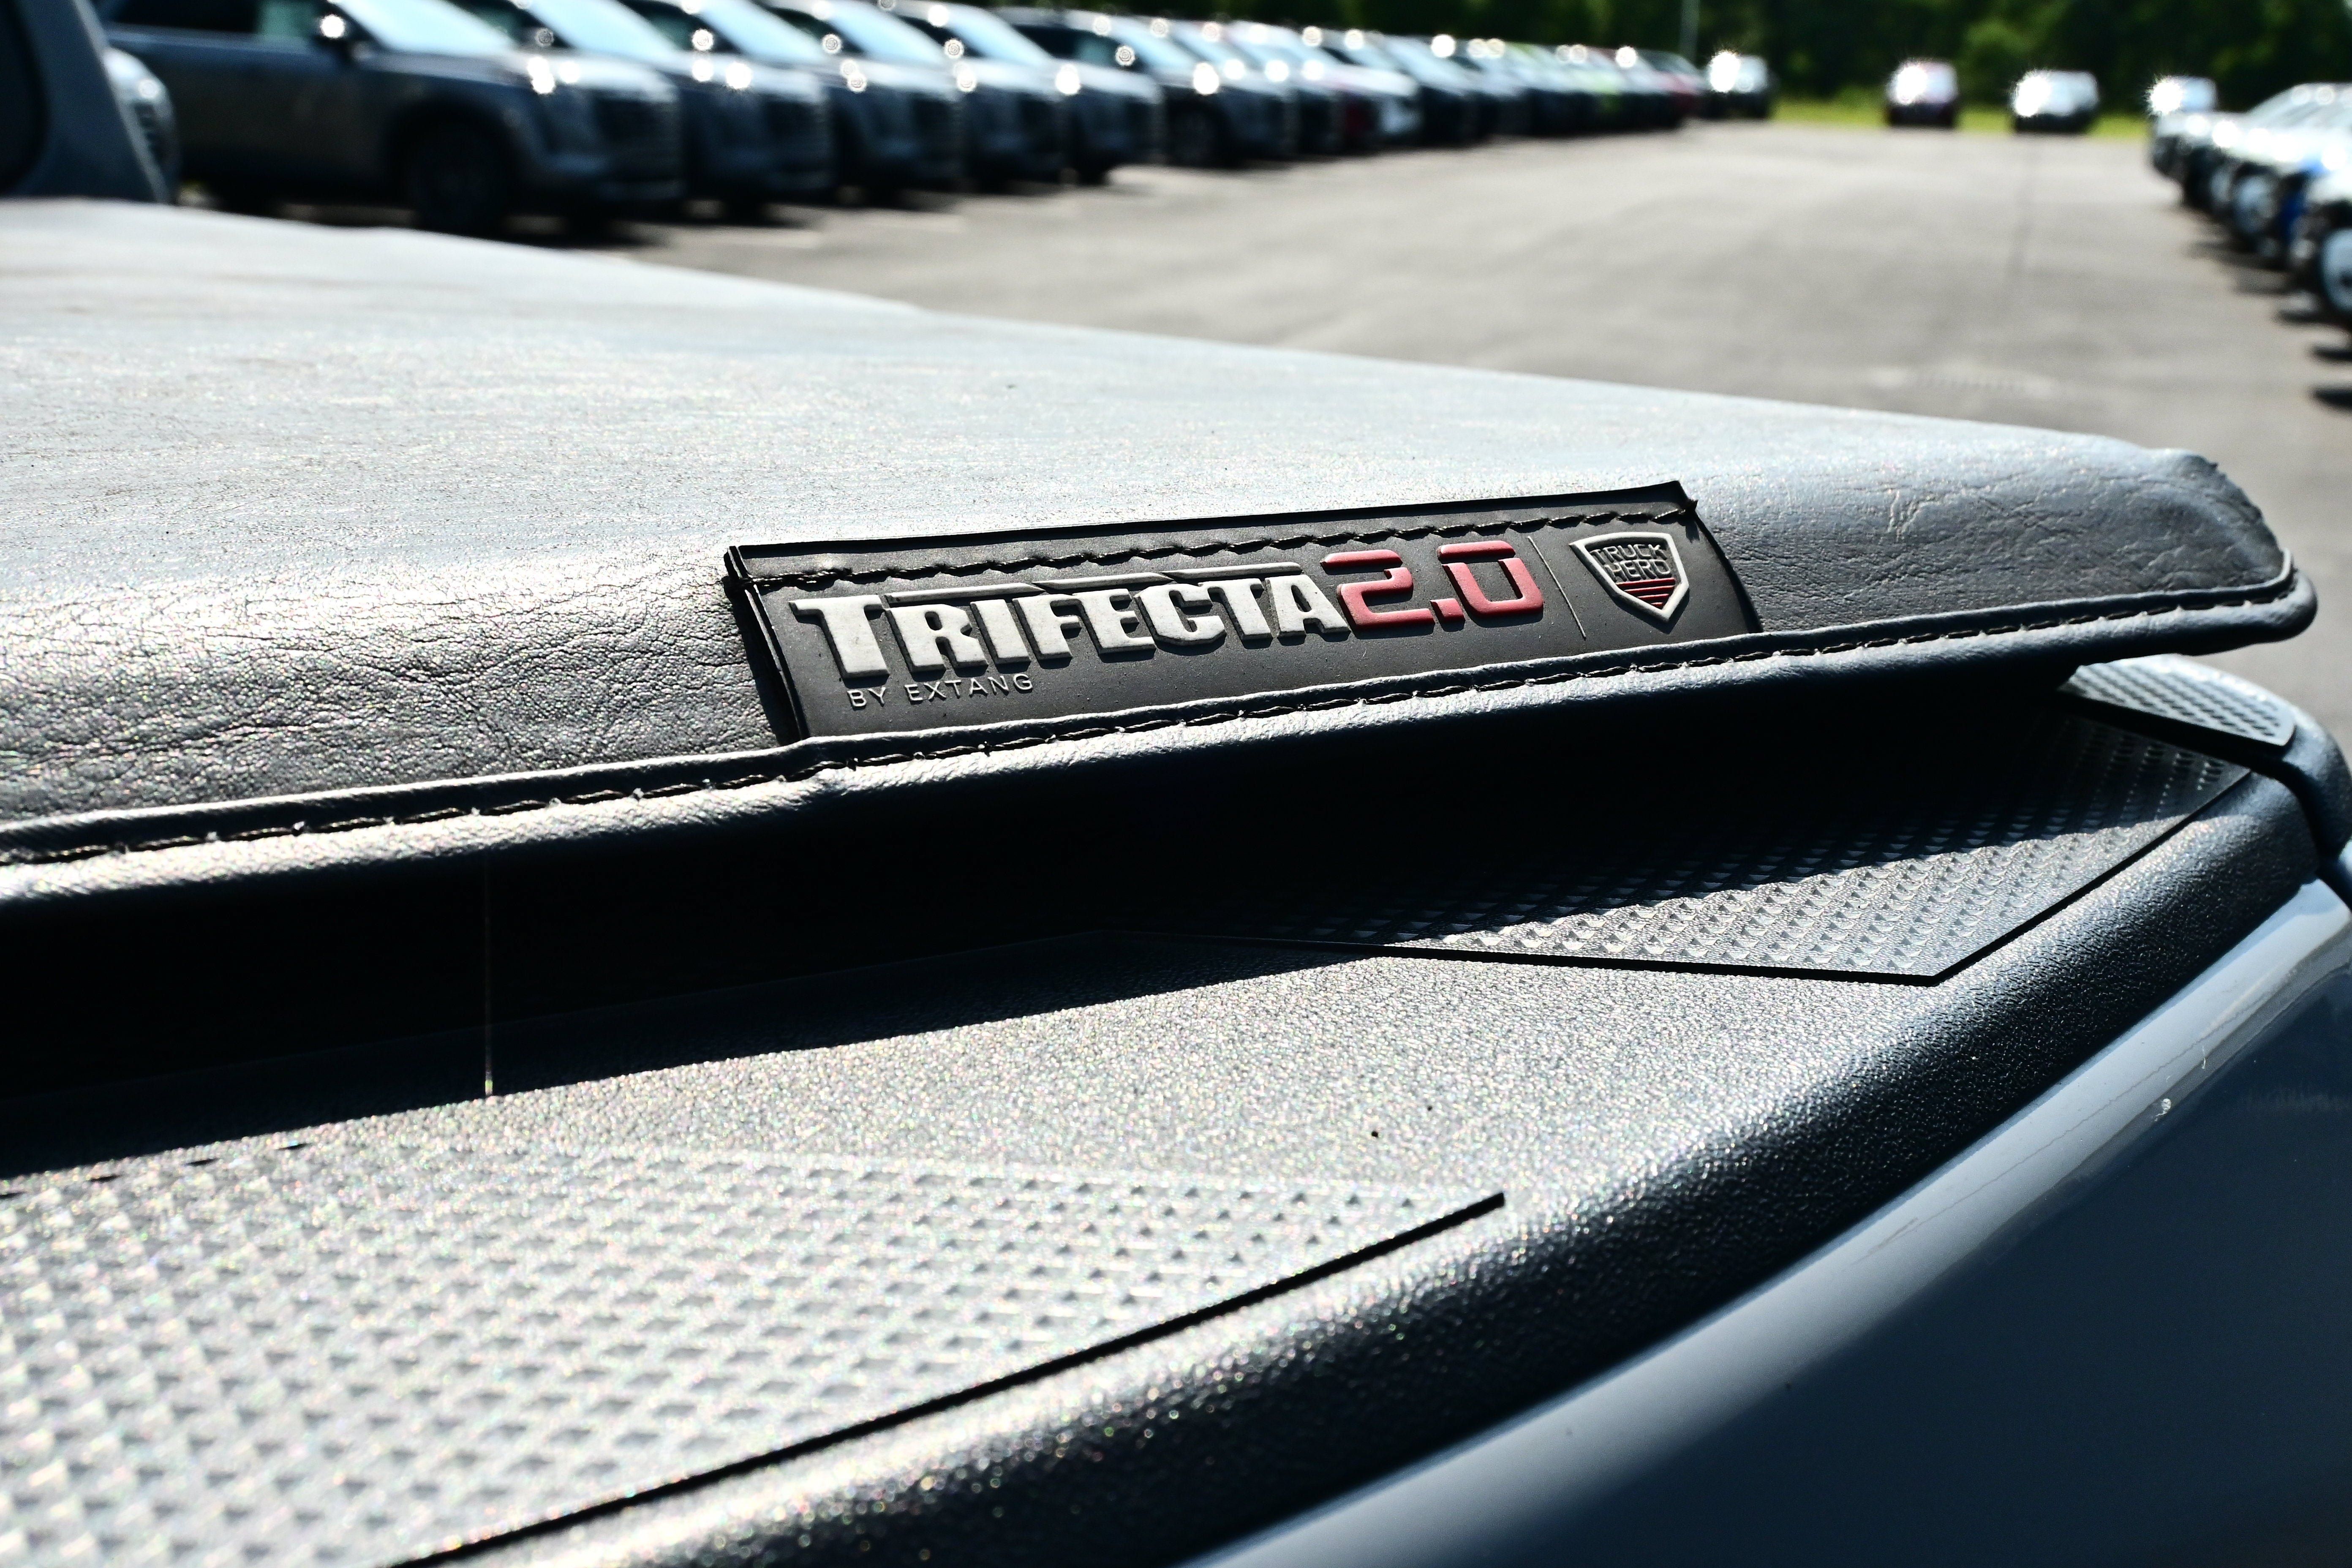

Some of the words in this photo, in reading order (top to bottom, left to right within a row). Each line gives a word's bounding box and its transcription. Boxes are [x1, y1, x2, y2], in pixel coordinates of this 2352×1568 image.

[1589, 544, 1668, 565] TRUCK
[1604, 559, 1672, 583] HERO
[789, 574, 1351, 680] TRIFECTA
[1320, 539, 1544, 629] 2.0
[847, 686, 887, 709] BY
[904, 673, 1033, 702] EXTANG
